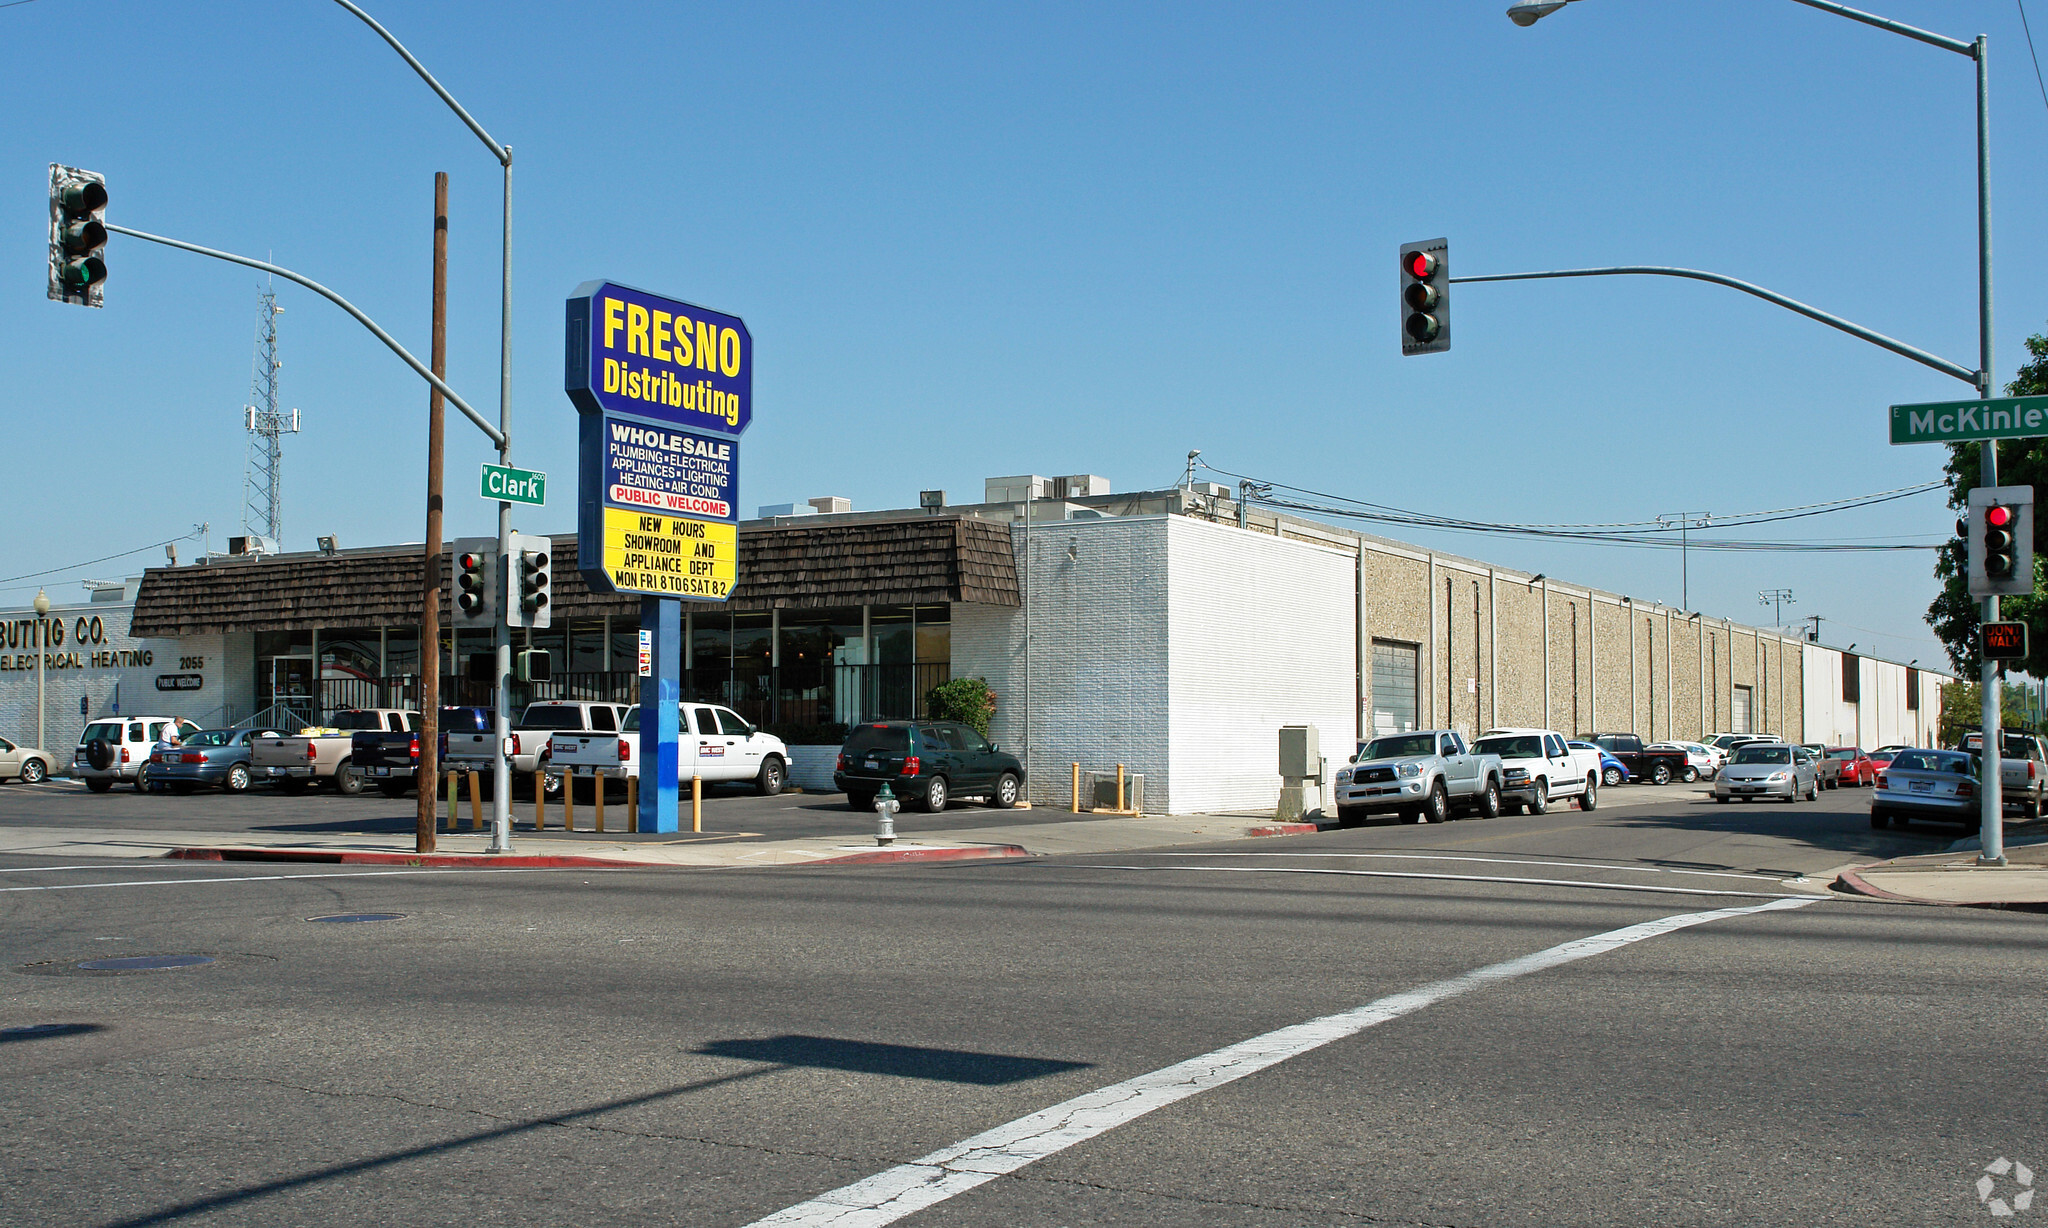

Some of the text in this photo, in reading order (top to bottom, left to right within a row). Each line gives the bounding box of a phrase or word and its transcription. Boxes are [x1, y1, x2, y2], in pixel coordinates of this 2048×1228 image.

[604, 297, 741, 378] FRESNO
[603, 357, 739, 426] Distributing
[1893, 408, 1900, 417] E
[611, 423, 731, 461] WHOLESALE
[483, 466, 488, 475] N
[610, 442, 730, 475] PLUMBING ELECTRICAL
[612, 457, 728, 487] APPLIANCES LIGHTING
[488, 471, 538, 499] Clark
[620, 471, 721, 500] HEATING AIR COND.
[616, 487, 726, 516] PUBLIC WELCOME
[639, 516, 705, 538] NEW HOURS
[624, 534, 715, 558] SHOWROOM AND
[624, 553, 715, 577] APPLIANCE DEPT
[615, 570, 637, 588] MON
[640, 573, 657, 589] FRI
[75, 616, 109, 645] CO.
[1986, 625, 2021, 636] DONT
[1986, 635, 2021, 647] WALK
[91, 650, 153, 669] HEATING
[179, 656, 204, 670] 2055
[158, 677, 201, 688] PUBLIC WELCOME
